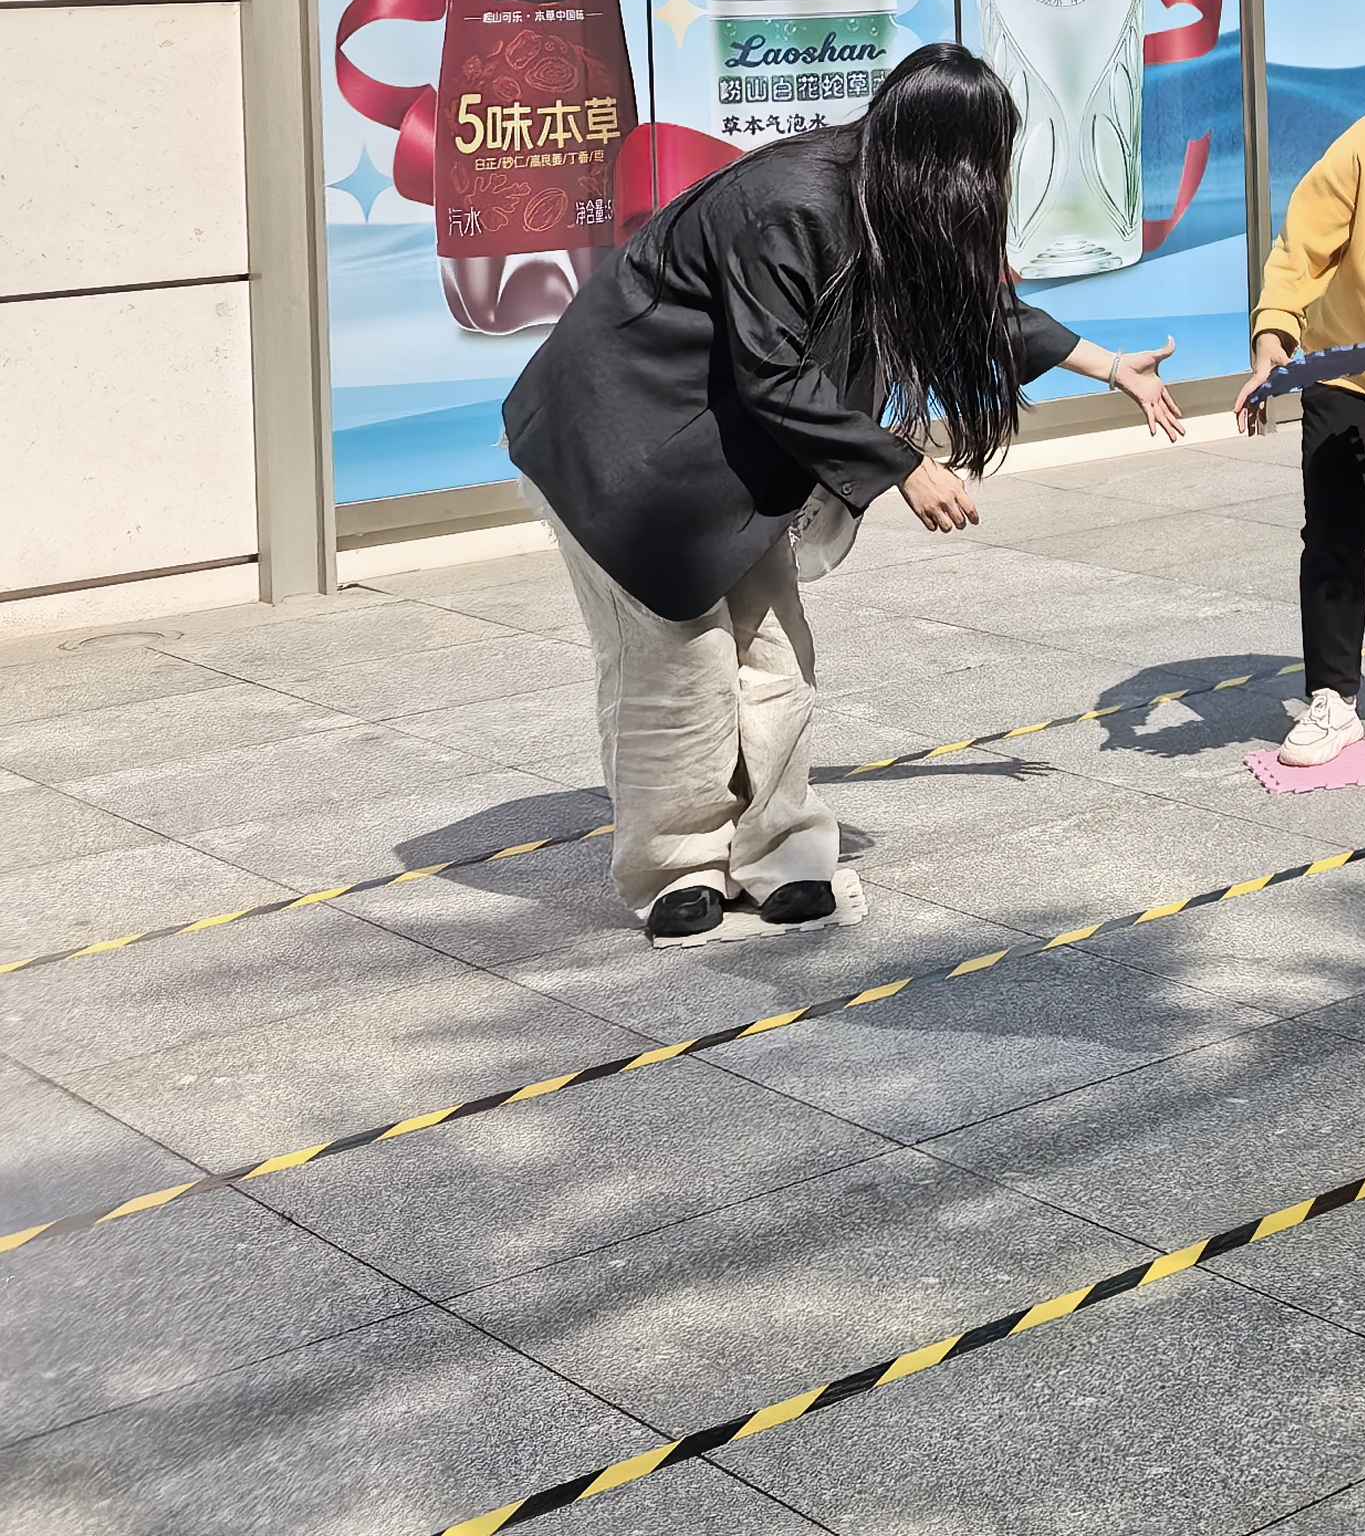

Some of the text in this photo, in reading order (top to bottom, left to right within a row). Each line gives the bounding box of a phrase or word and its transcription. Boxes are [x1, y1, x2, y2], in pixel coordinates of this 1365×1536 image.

[725, 31, 887, 68] Laoshan
[455, 93, 621, 154] 5味本草
[448, 206, 482, 237] 汽水
